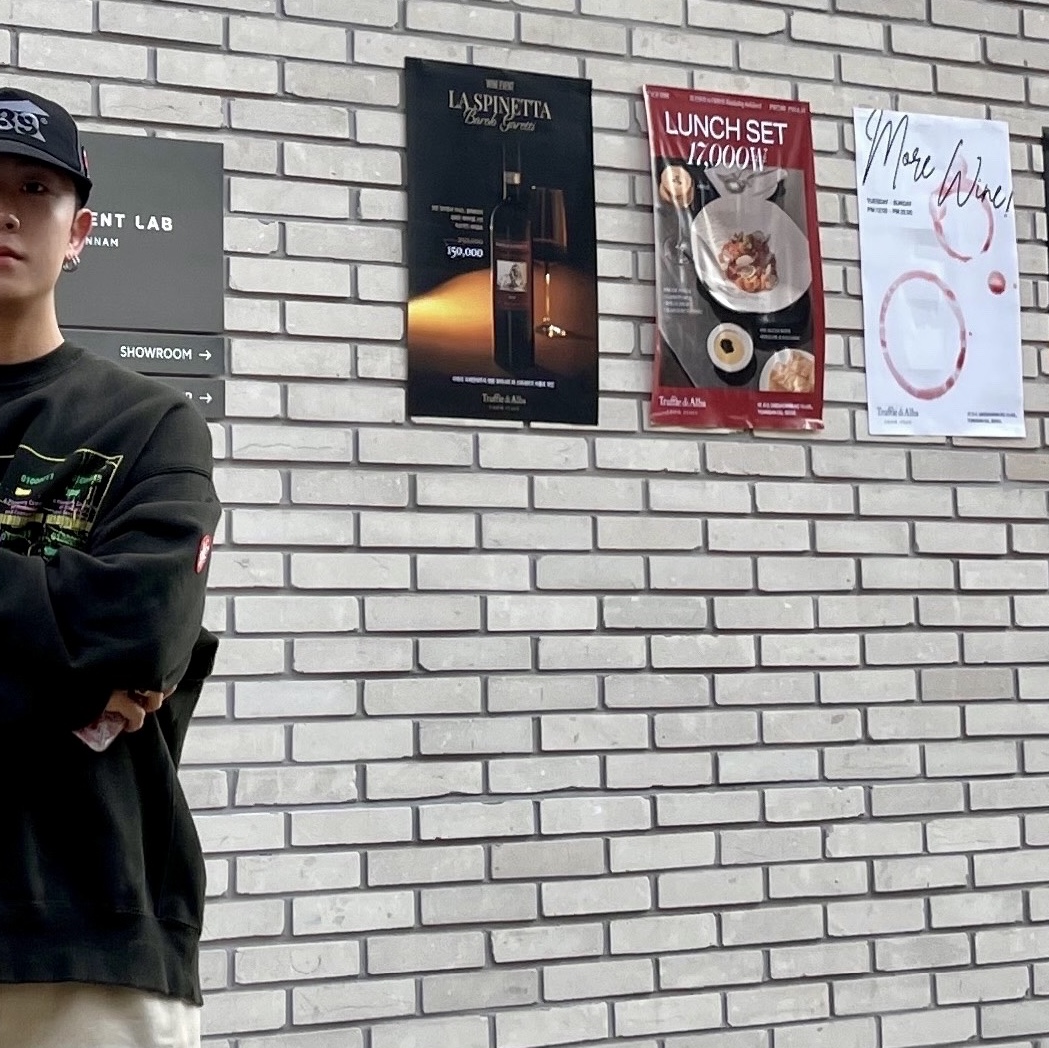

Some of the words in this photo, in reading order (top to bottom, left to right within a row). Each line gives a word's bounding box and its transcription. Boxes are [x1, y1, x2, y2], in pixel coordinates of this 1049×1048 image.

[448, 89, 469, 111] LA
[473, 93, 552, 120] SPINETTA
[664, 110, 741, 141] LUNCH
[745, 118, 788, 145] SET
[862, 108, 936, 190] More
[937, 138, 1015, 218] Wine!
[91, 211, 126, 228] ENT
[135, 214, 173, 232] LAB
[85, 236, 119, 248] NNAM
[446, 245, 484, 260] 150,000
[120, 345, 193, 361] SHOWROOM
